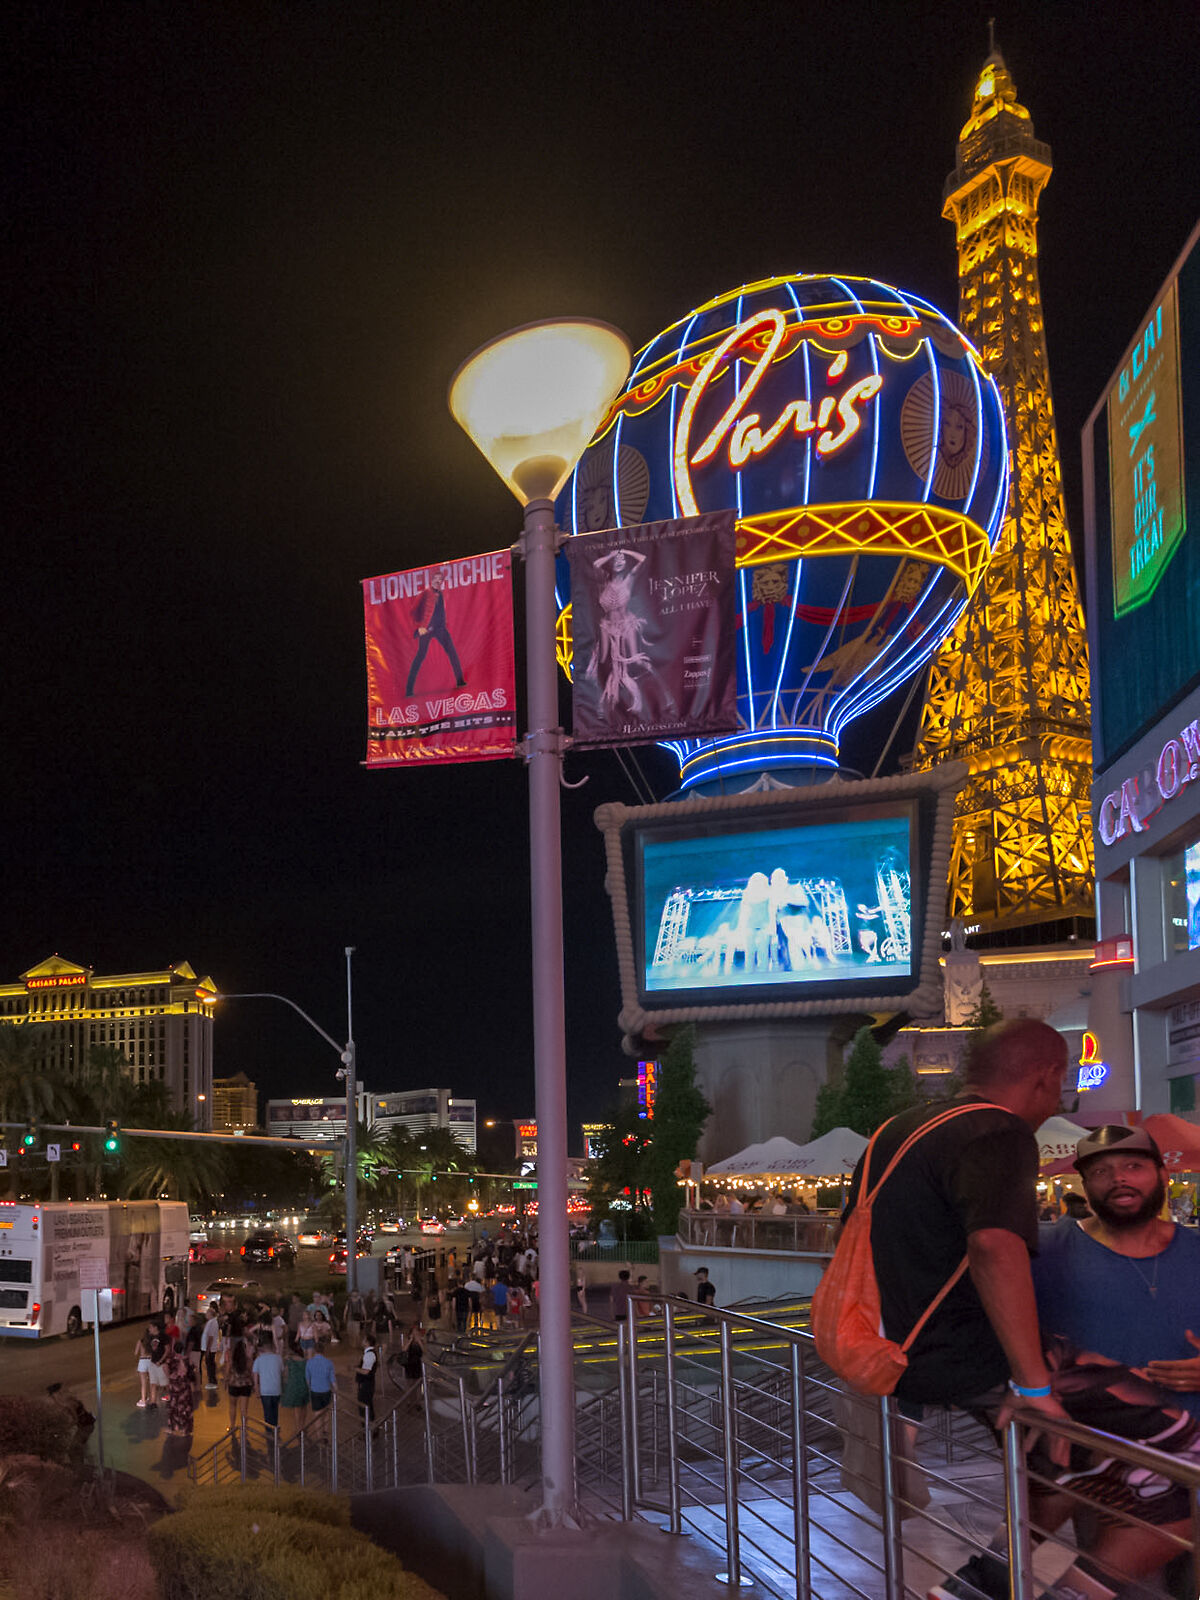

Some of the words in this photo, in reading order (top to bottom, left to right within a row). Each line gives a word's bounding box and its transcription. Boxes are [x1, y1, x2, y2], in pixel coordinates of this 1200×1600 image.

[675, 308, 884, 518] Paris
[1134, 481, 1157, 537] OUR
[1129, 506, 1164, 581] TREAT
[369, 568, 430, 605] LIONEL
[440, 554, 504, 591] RICHIE
[648, 571, 720, 595] JENNIFER
[663, 582, 707, 600] LOPEZ
[376, 704, 420, 726] LAS
[425, 688, 507, 720] VEGAS
[419, 721, 451, 735] THE
[58, 975, 87, 986] PALACE
